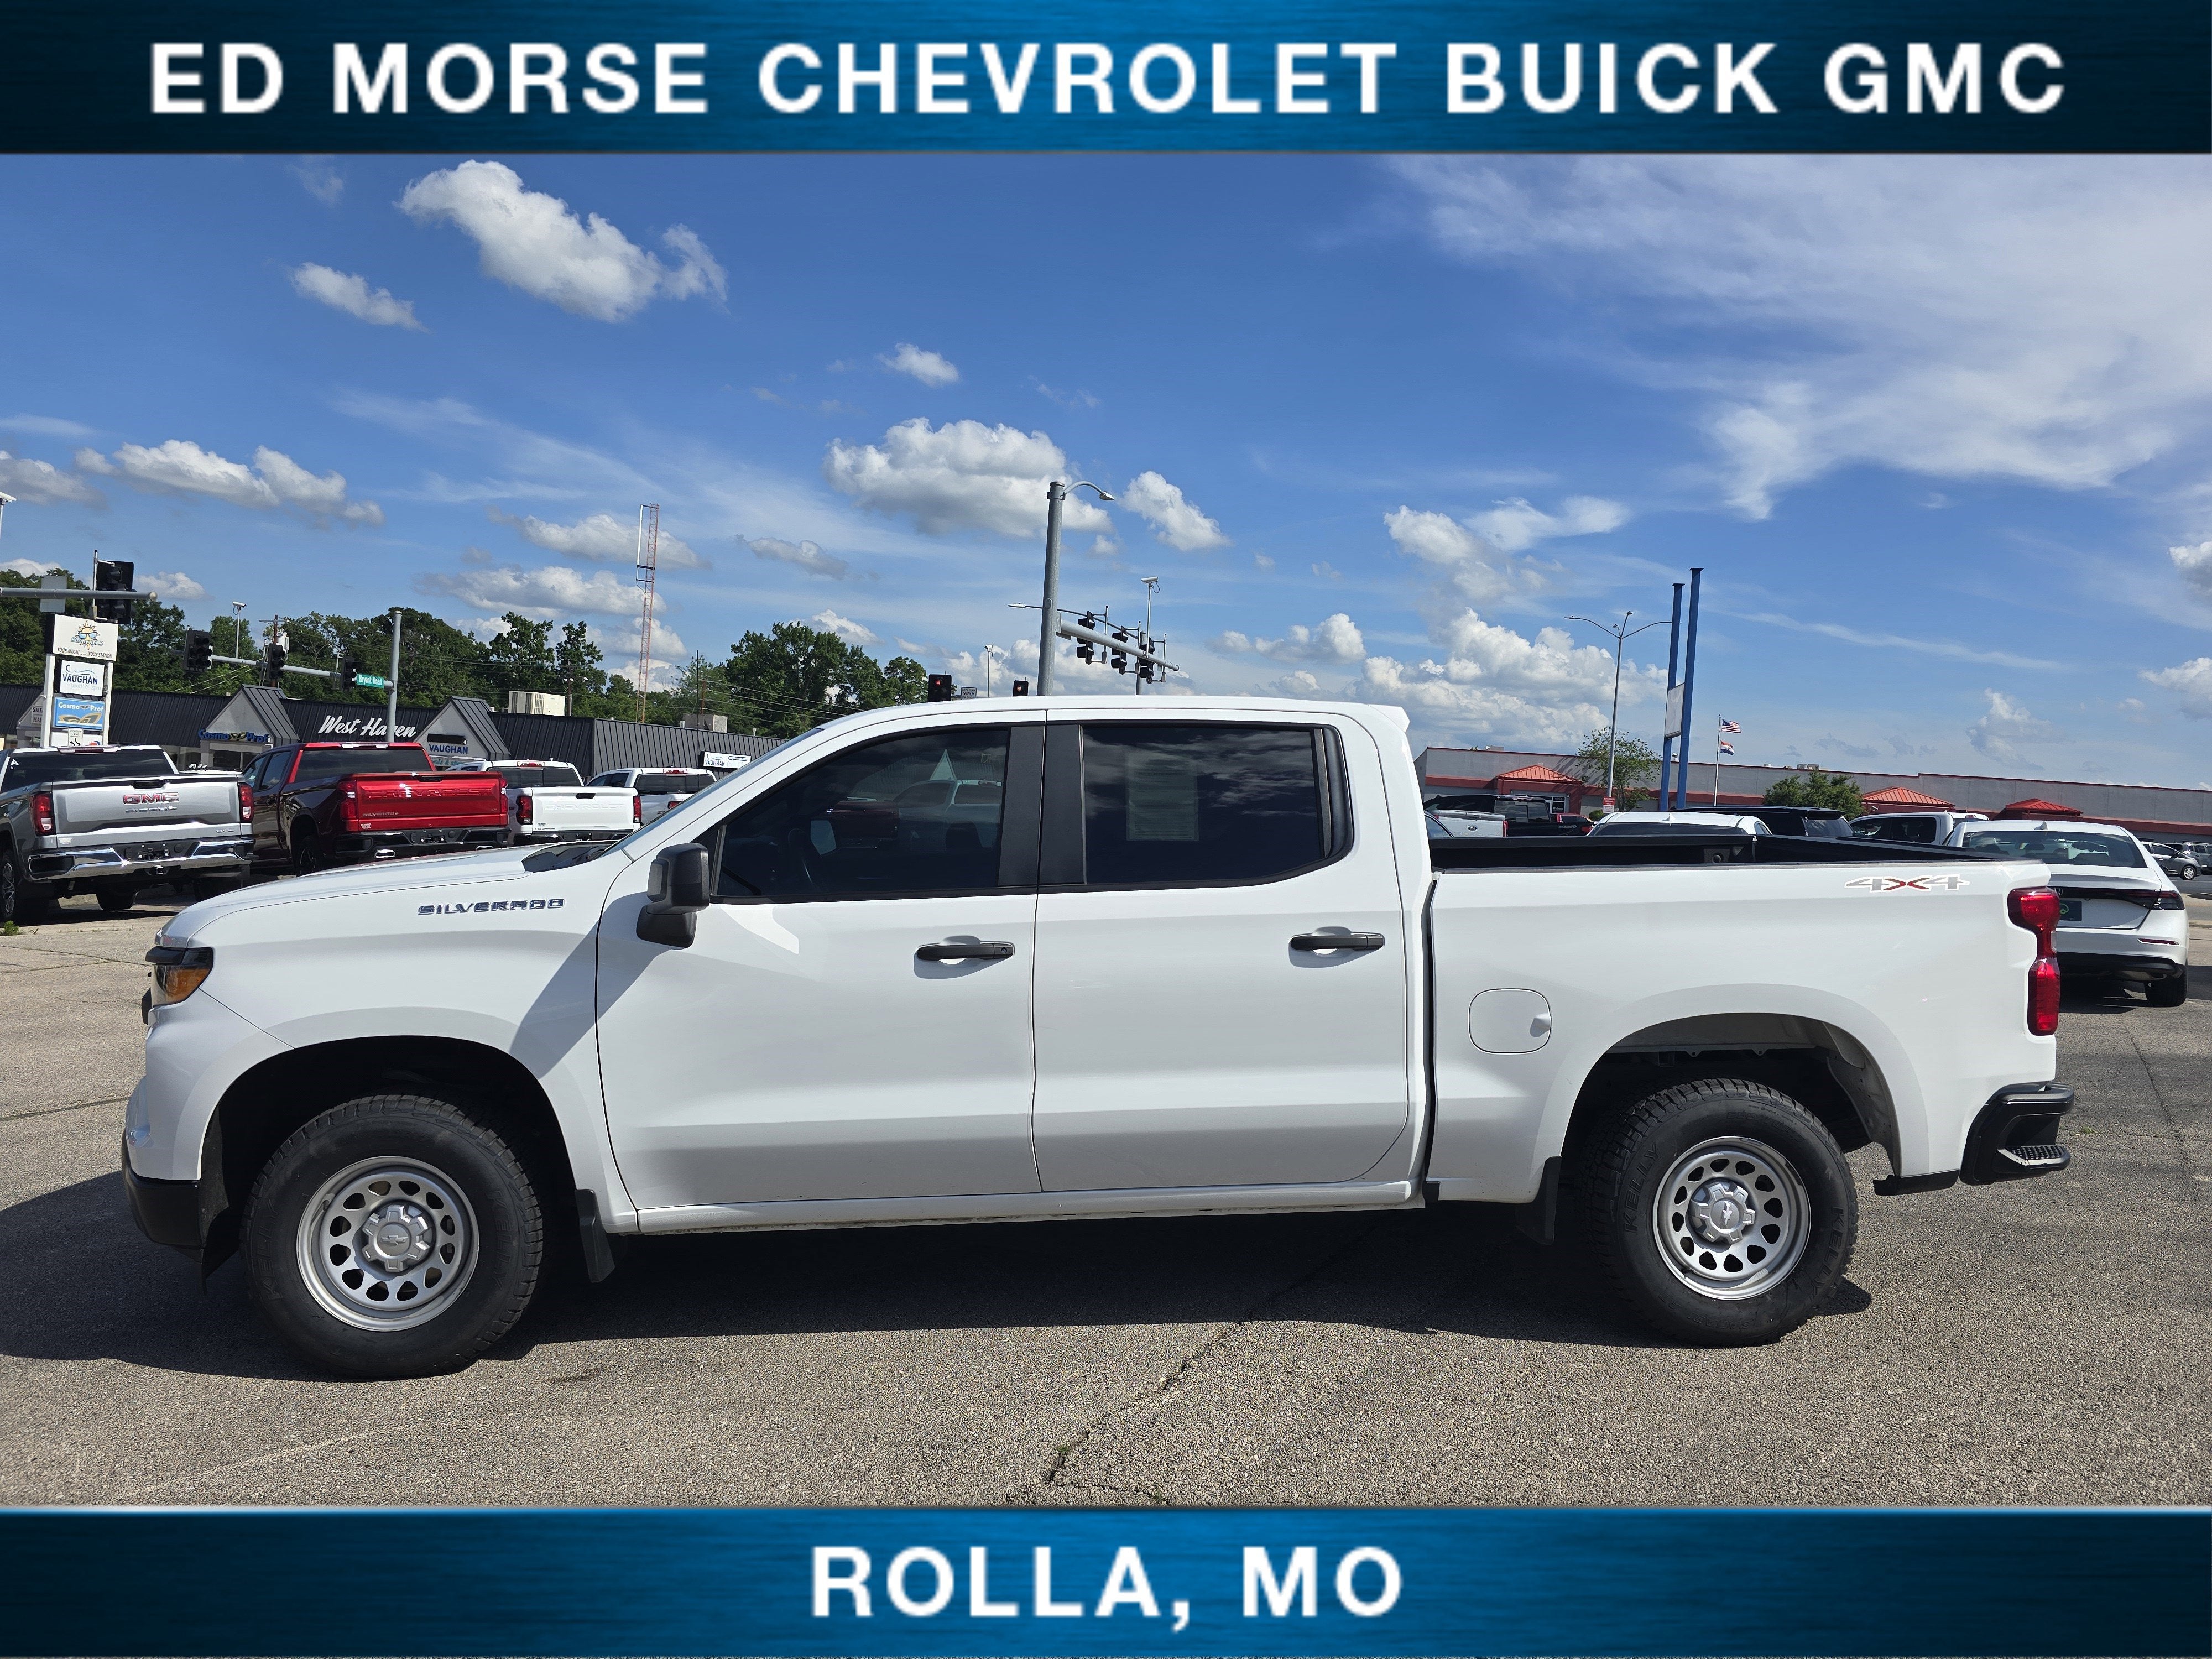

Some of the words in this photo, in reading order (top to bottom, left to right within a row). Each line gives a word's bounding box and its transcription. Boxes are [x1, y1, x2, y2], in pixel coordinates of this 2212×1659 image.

[62, 673, 98, 685] VAUGHAN
[359, 674, 372, 685] Bryant
[373, 676, 382, 686] Road
[58, 702, 80, 710] Cosmo
[318, 715, 361, 734] West
[359, 717, 417, 738] Haen
[198, 729, 231, 740] Cosmo
[247, 732, 270, 743] Prof
[429, 744, 468, 754] VAUGHAN
[122, 792, 179, 805] GMC
[368, 787, 492, 799] CHEVROLET
[418, 899, 565, 915] SILVERADO
[1624, 1142, 1660, 1233] KELLY
[1810, 1206, 1845, 1300] KELLY
